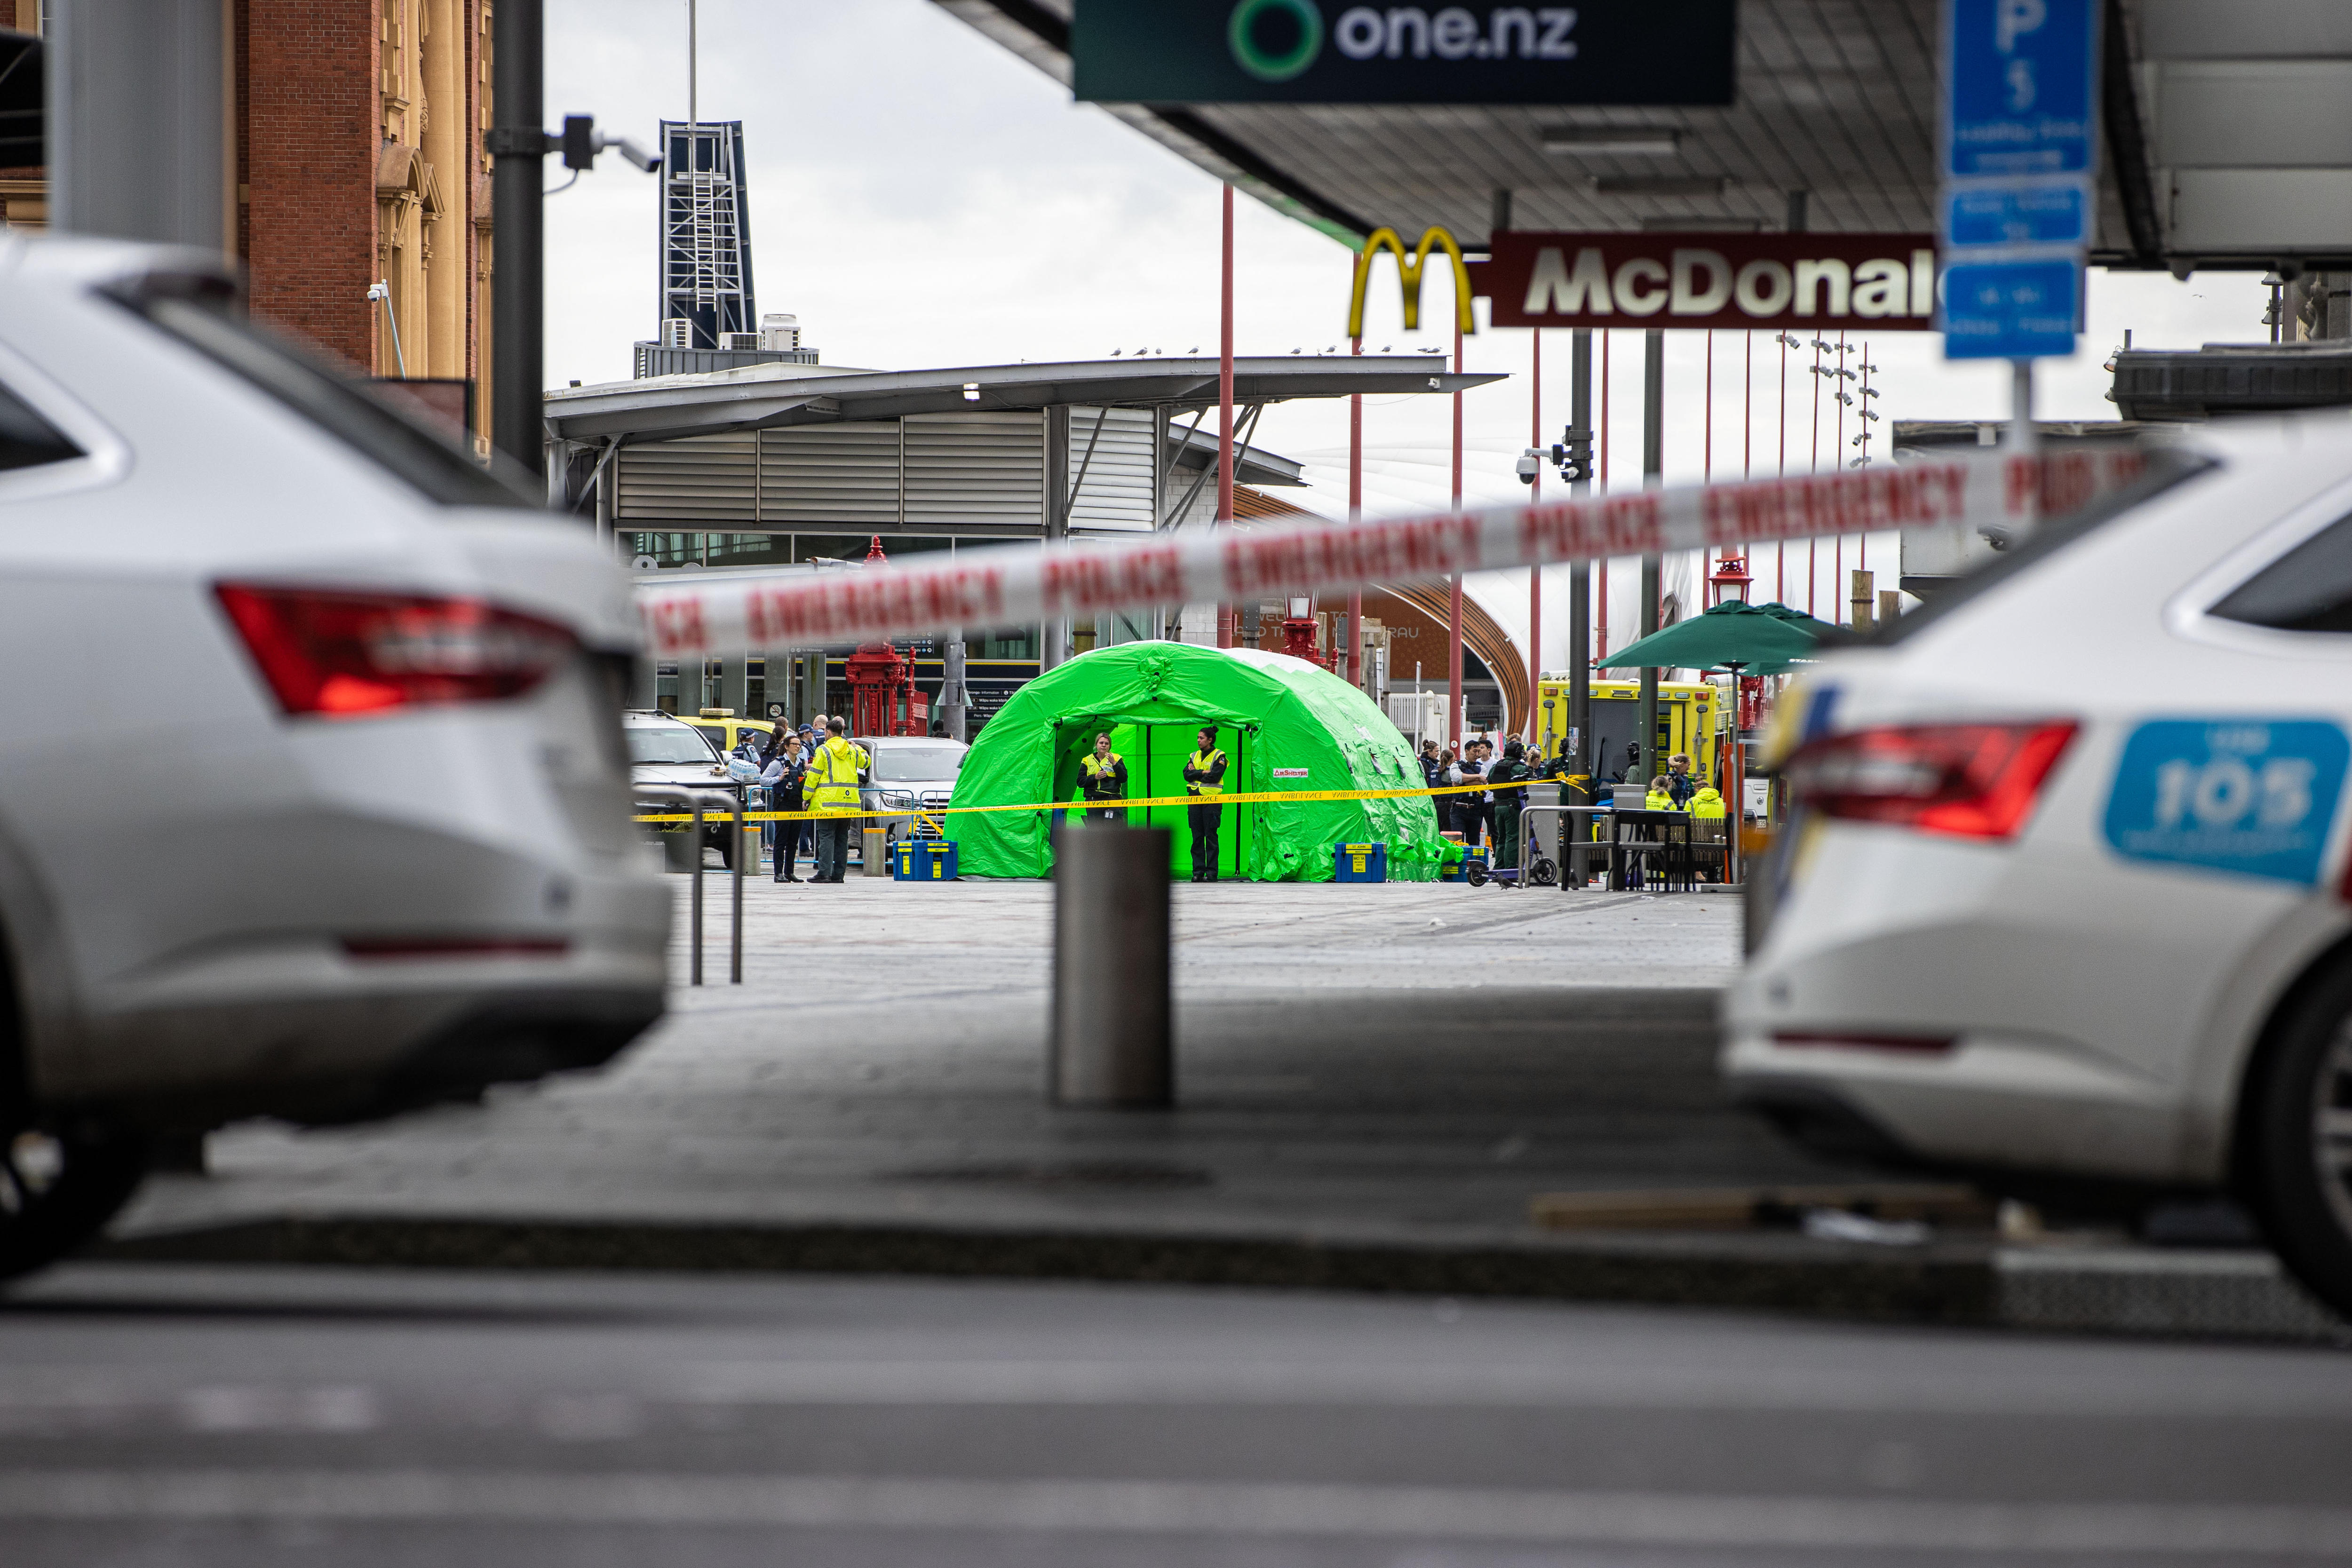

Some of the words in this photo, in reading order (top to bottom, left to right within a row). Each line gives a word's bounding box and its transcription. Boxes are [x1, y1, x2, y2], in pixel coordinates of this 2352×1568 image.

[1335, 6, 1579, 60] one.nz
[1994, 0, 2046, 53] P
[1523, 247, 1945, 317] McDonal
[747, 567, 1002, 643] EMERGENCY
[1041, 546, 1185, 610] POLICE
[1225, 512, 1482, 595] EMERGENCY
[1518, 492, 1669, 563] POLICE
[1699, 462, 1968, 544] EMERGENCY
[2153, 756, 2317, 828] 105
